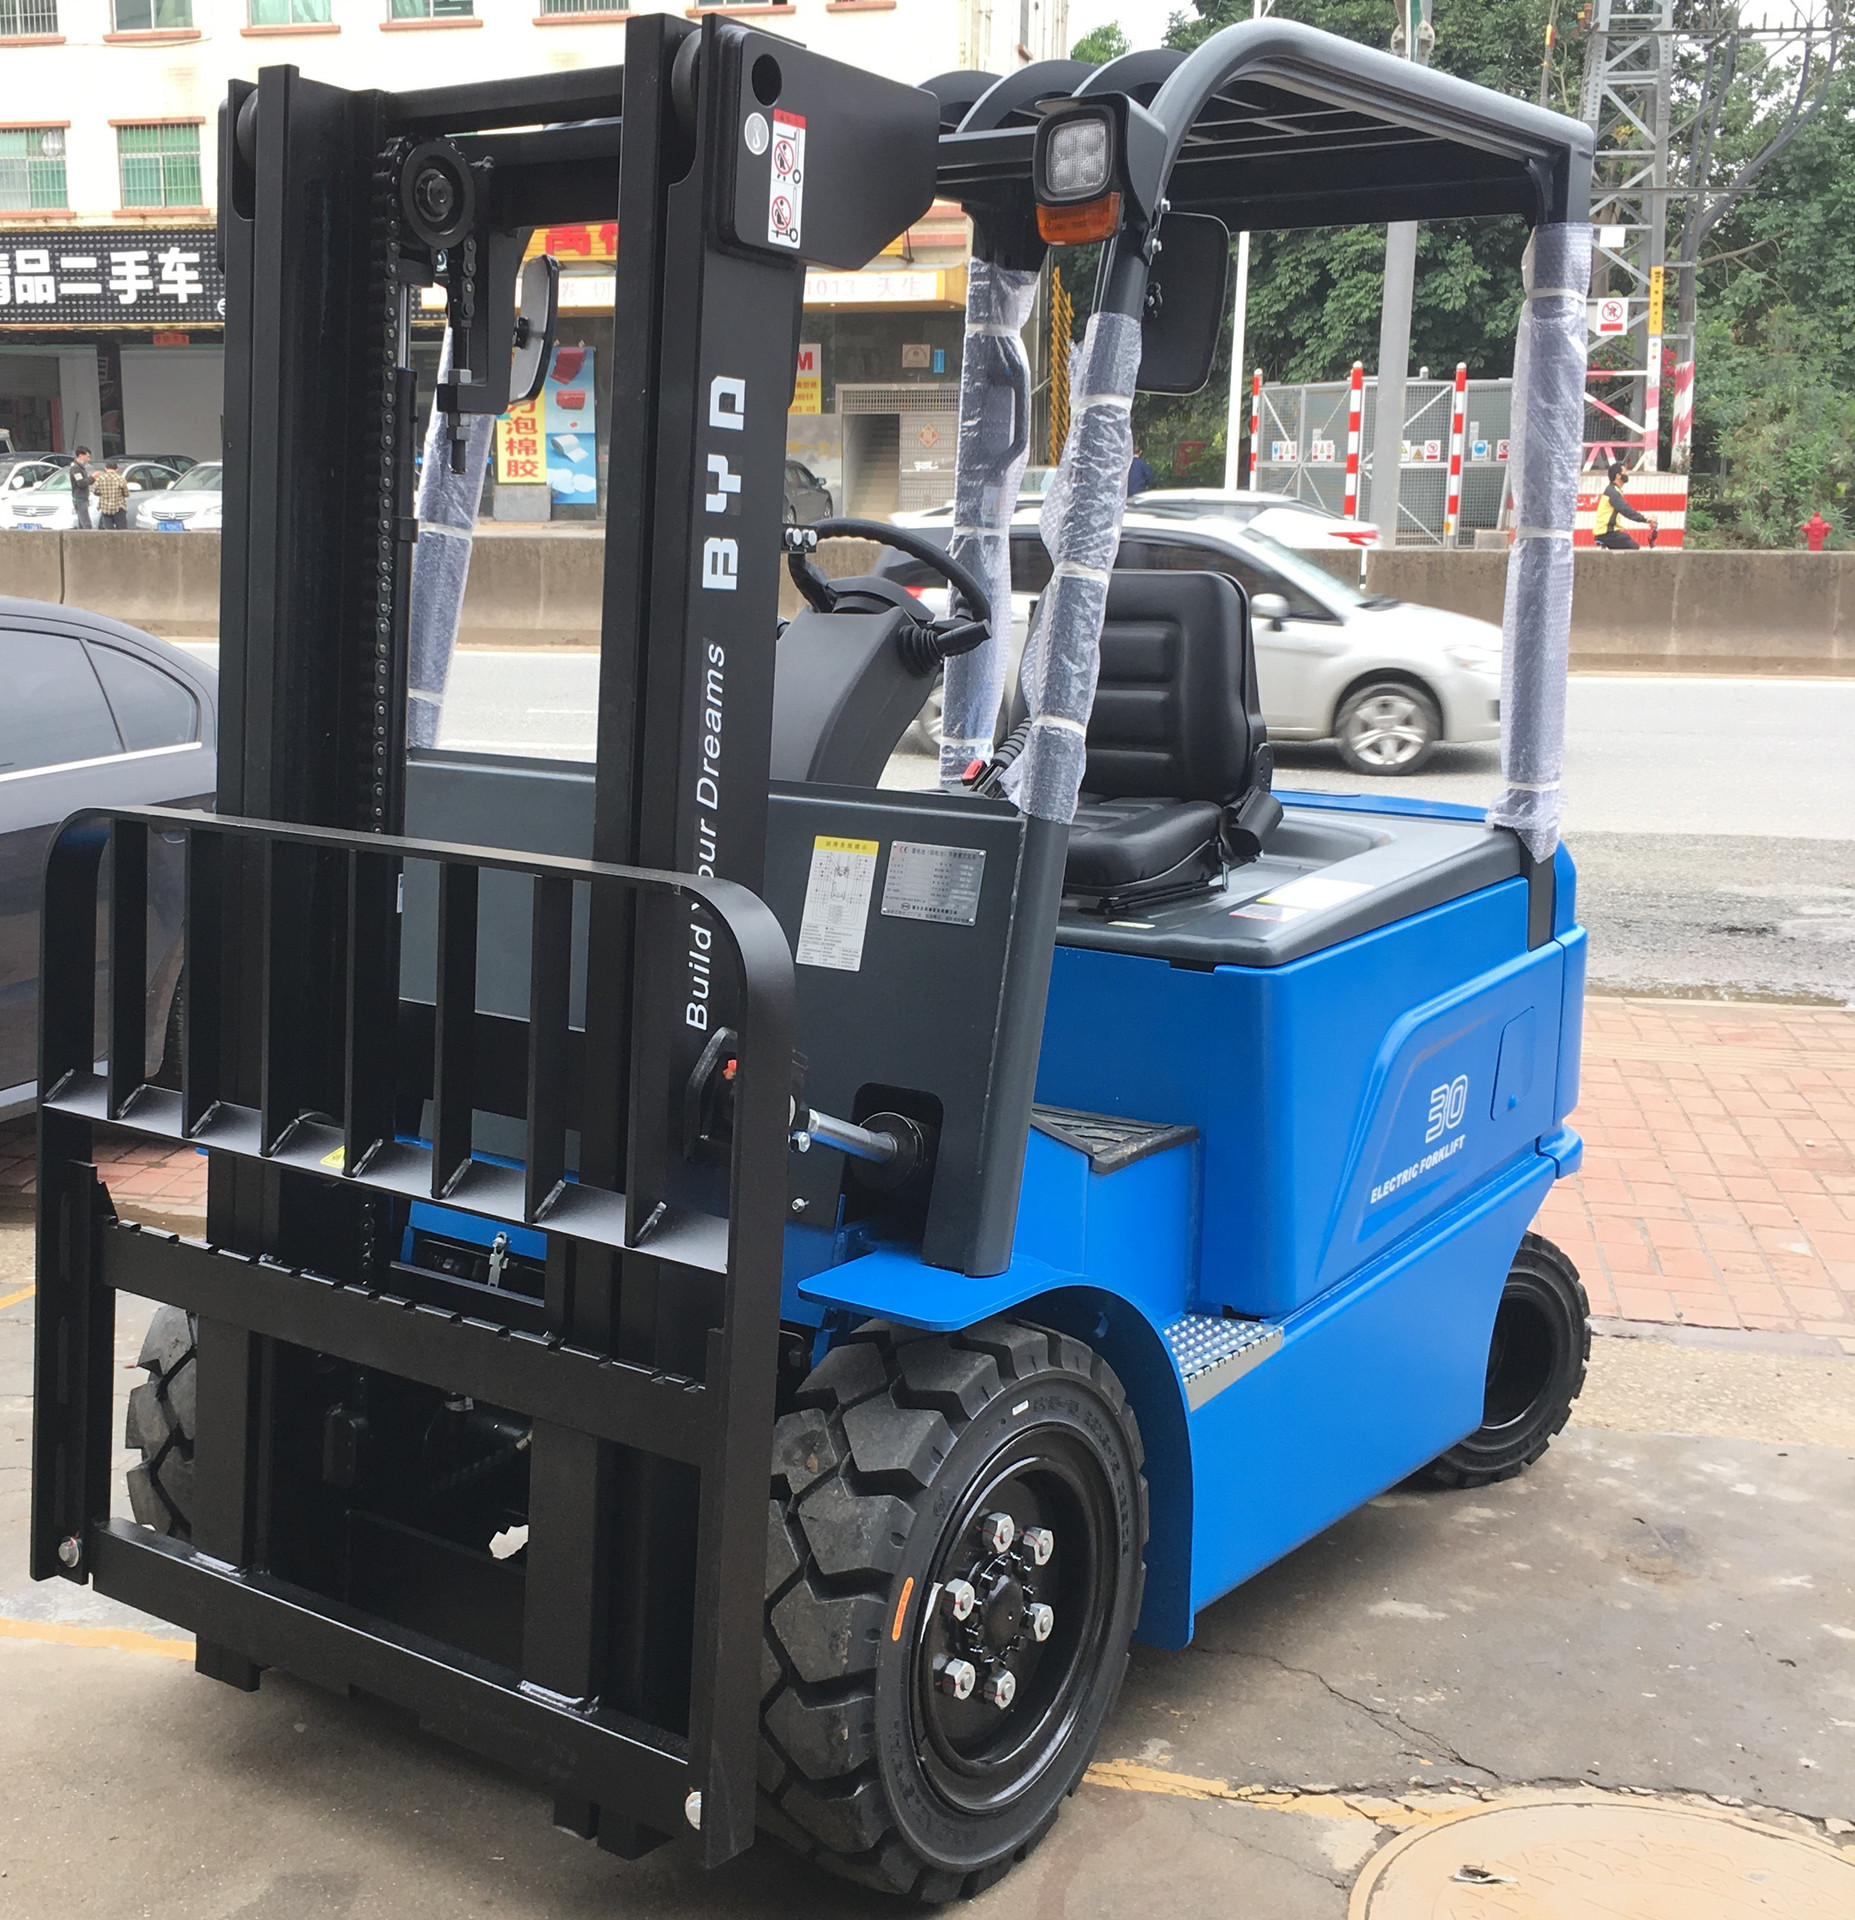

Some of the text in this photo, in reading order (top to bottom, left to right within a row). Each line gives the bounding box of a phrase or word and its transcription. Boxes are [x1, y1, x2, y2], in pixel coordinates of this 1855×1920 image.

[0, 247, 203, 305] 品二手车
[702, 376, 746, 590] BYD
[696, 643, 725, 810] Dreams
[685, 923, 712, 1031] Build
[1425, 1074, 1469, 1143] 30
[1370, 1134, 1466, 1205] ELECTRIC FORKLIFT
